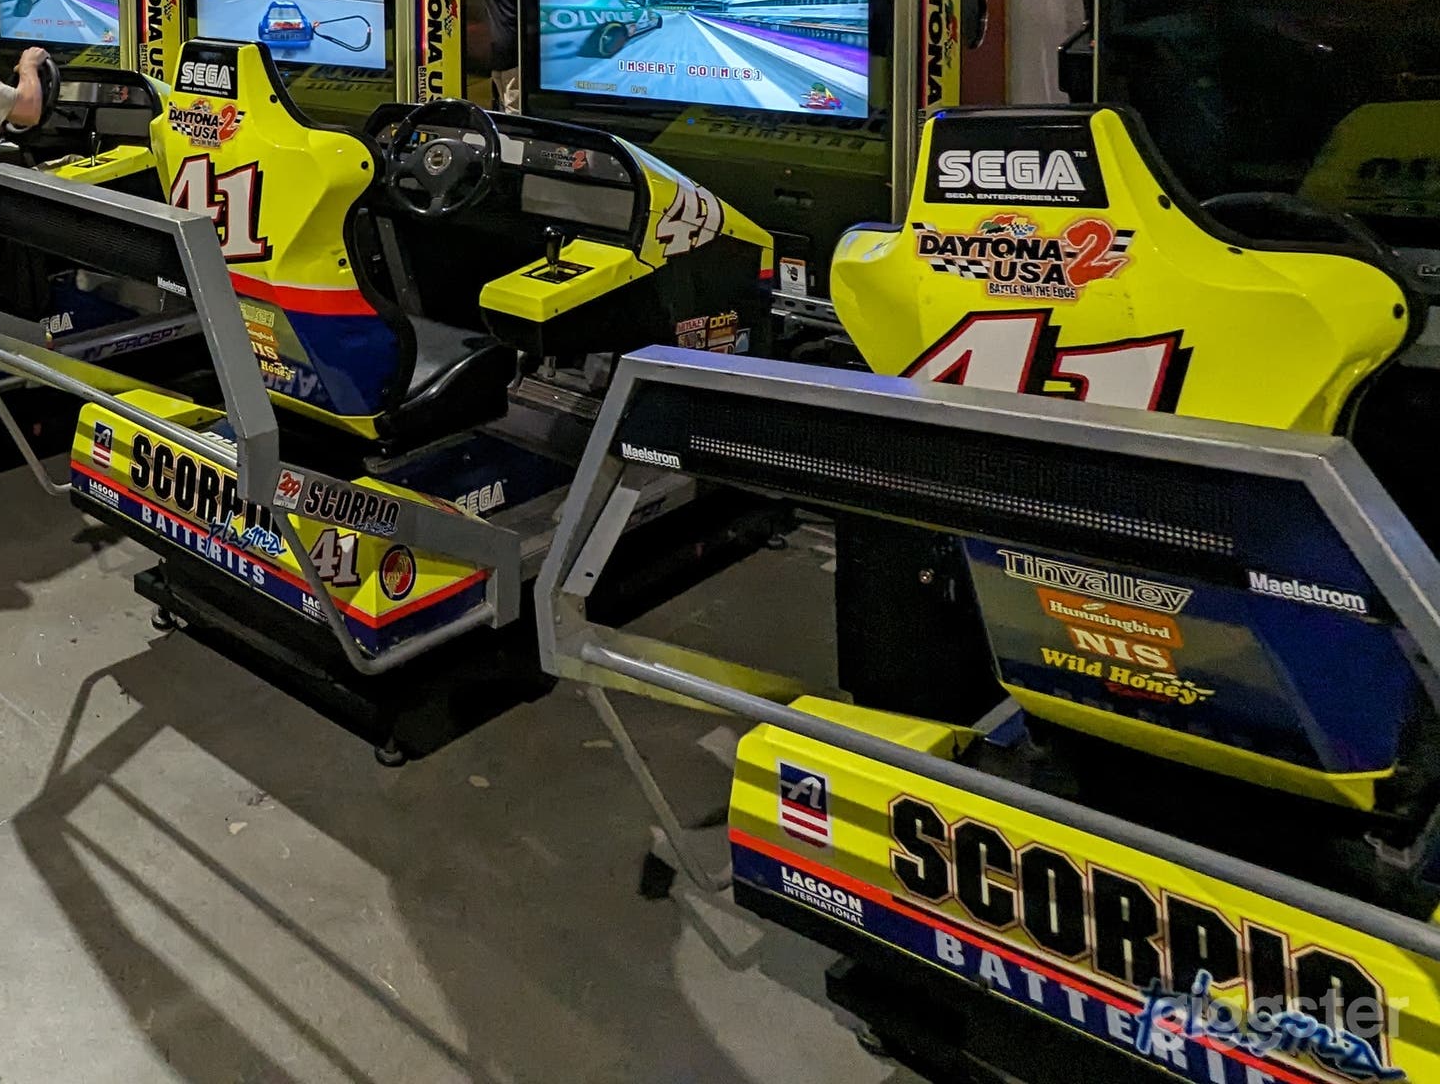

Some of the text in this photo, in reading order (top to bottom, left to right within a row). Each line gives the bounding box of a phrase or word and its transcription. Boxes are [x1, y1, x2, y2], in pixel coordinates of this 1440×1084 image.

[147, 49, 164, 82] US
[180, 61, 232, 90] SEGA
[168, 103, 241, 141] DAYTONA 2
[193, 124, 218, 141] USA
[937, 149, 1087, 191] SEGA
[169, 152, 274, 265] 41
[918, 218, 1130, 288] DAYTONA 2
[992, 260, 1067, 286] USA
[988, 282, 1018, 295] BATTLE
[1034, 284, 1051, 297] THE
[1052, 287, 1076, 299] EDGE
[621, 442, 681, 469] Maelstrom
[88, 478, 120, 501] LAGOON
[303, 480, 401, 530] SCORPIO
[141, 503, 265, 585] BATTERIES
[207, 510, 288, 558] plasma
[310, 528, 360, 587] 41
[997, 548, 1194, 615] Tinvalley
[1249, 571, 1368, 615] Maelstrom
[1048, 599, 1171, 641] Hummingbird
[1040, 647, 1103, 680] Wild
[1072, 627, 1170, 671] NIS
[780, 866, 863, 913] LAGOON
[782, 883, 864, 927] INTERNATIONAL
[888, 792, 1393, 1073] SCORPIO
[934, 928, 1276, 1084] BATTERI
